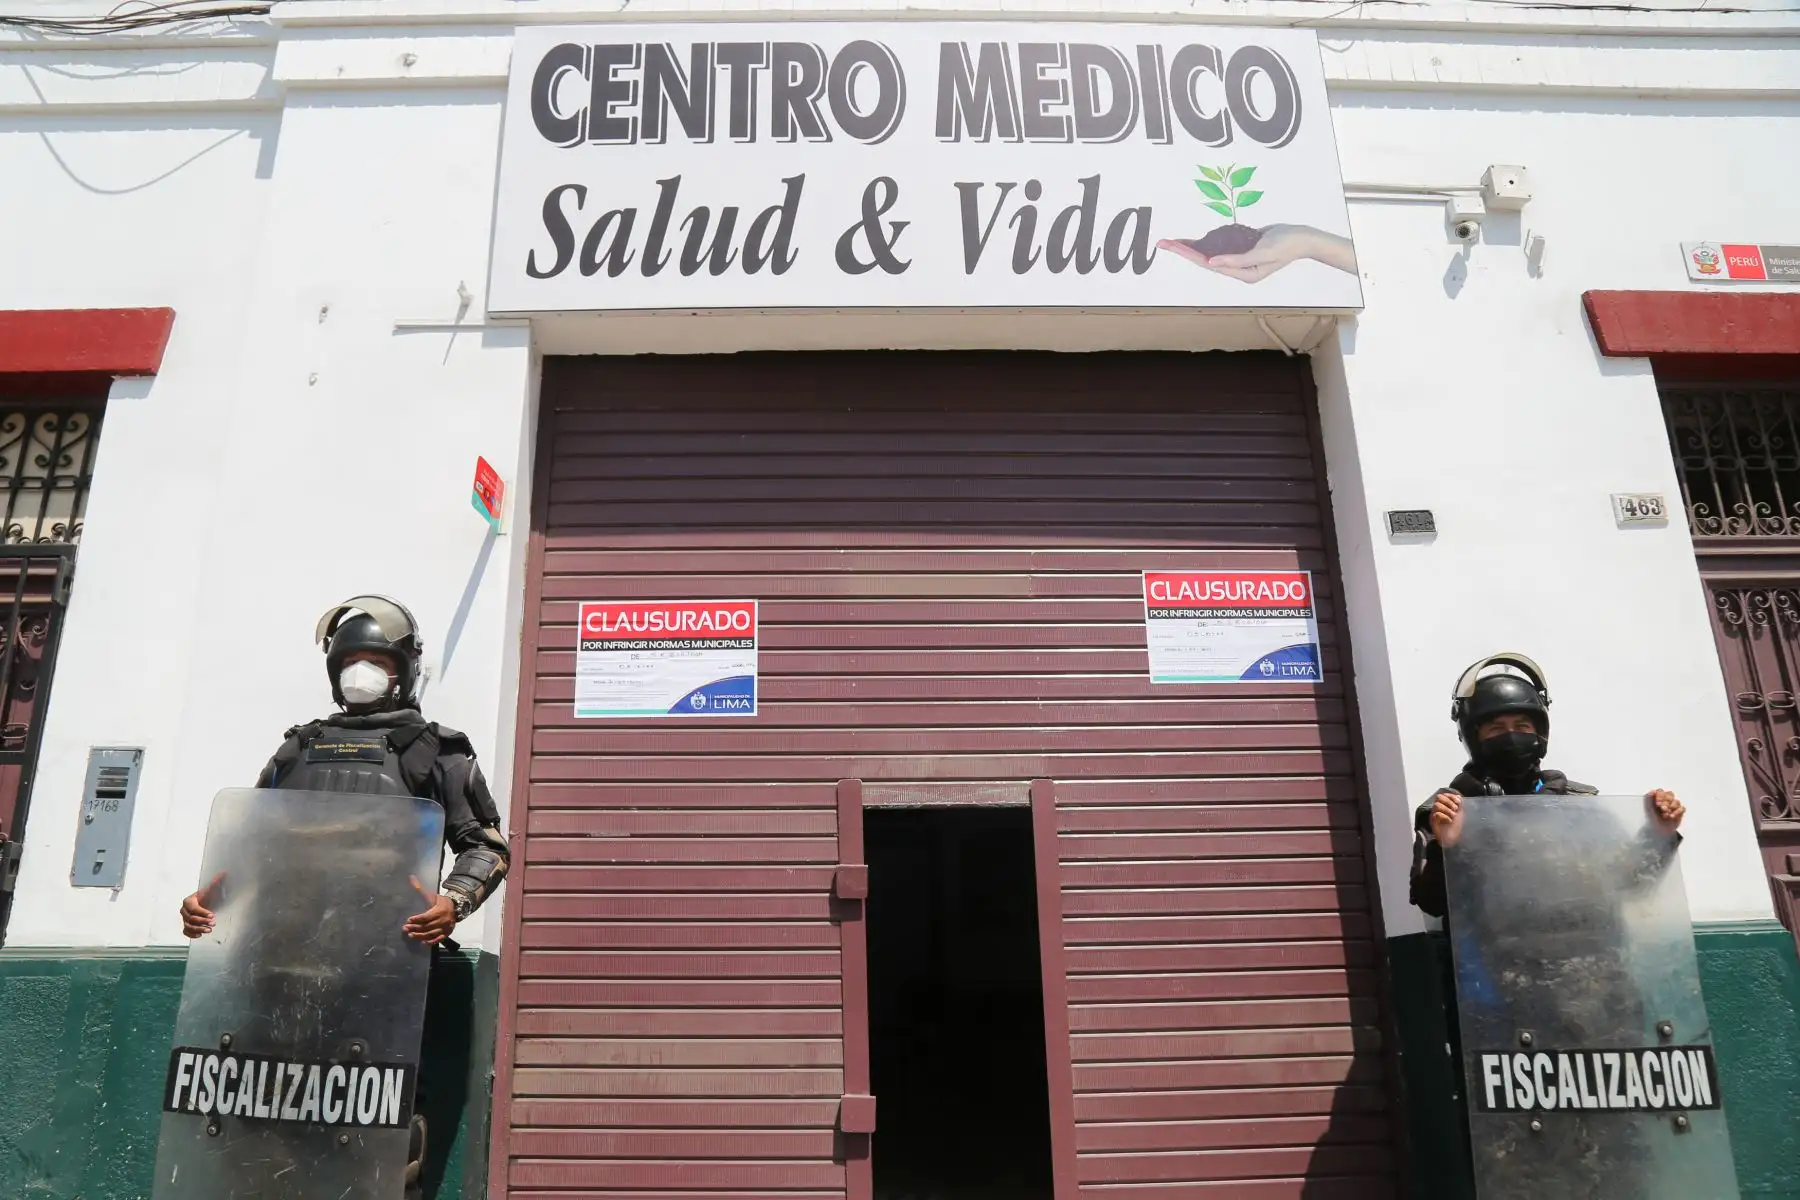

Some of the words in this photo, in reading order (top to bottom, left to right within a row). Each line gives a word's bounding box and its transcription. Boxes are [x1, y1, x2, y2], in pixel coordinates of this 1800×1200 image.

[531, 39, 907, 148] CENTRO
[935, 41, 1302, 149] MEDICO
[526, 173, 806, 279] Salud
[834, 176, 912, 275] &
[953, 174, 1157, 276] Vida
[1729, 255, 1759, 267] PERÚ
[1771, 266, 1783, 274] de
[1625, 498, 1662, 516] 463
[1150, 580, 1306, 600] CLAUSURADO
[585, 610, 751, 632] CLAUSURADO
[1150, 610, 1169, 618] POR
[1169, 609, 1213, 618] INFRINGIR
[1213, 609, 1253, 617] NORMAS
[1253, 609, 1311, 617] MUNICIPALES
[582, 641, 602, 650] POR
[603, 640, 648, 650] INFRINGIR
[649, 640, 691, 649] NORMAS
[691, 639, 753, 648] MUNICIPALES
[1282, 666, 1316, 676] LIMA
[714, 699, 751, 709] LIMA
[172, 1052, 404, 1125] FISCALIZACION
[1481, 1050, 1713, 1110] FISCALIZACION
